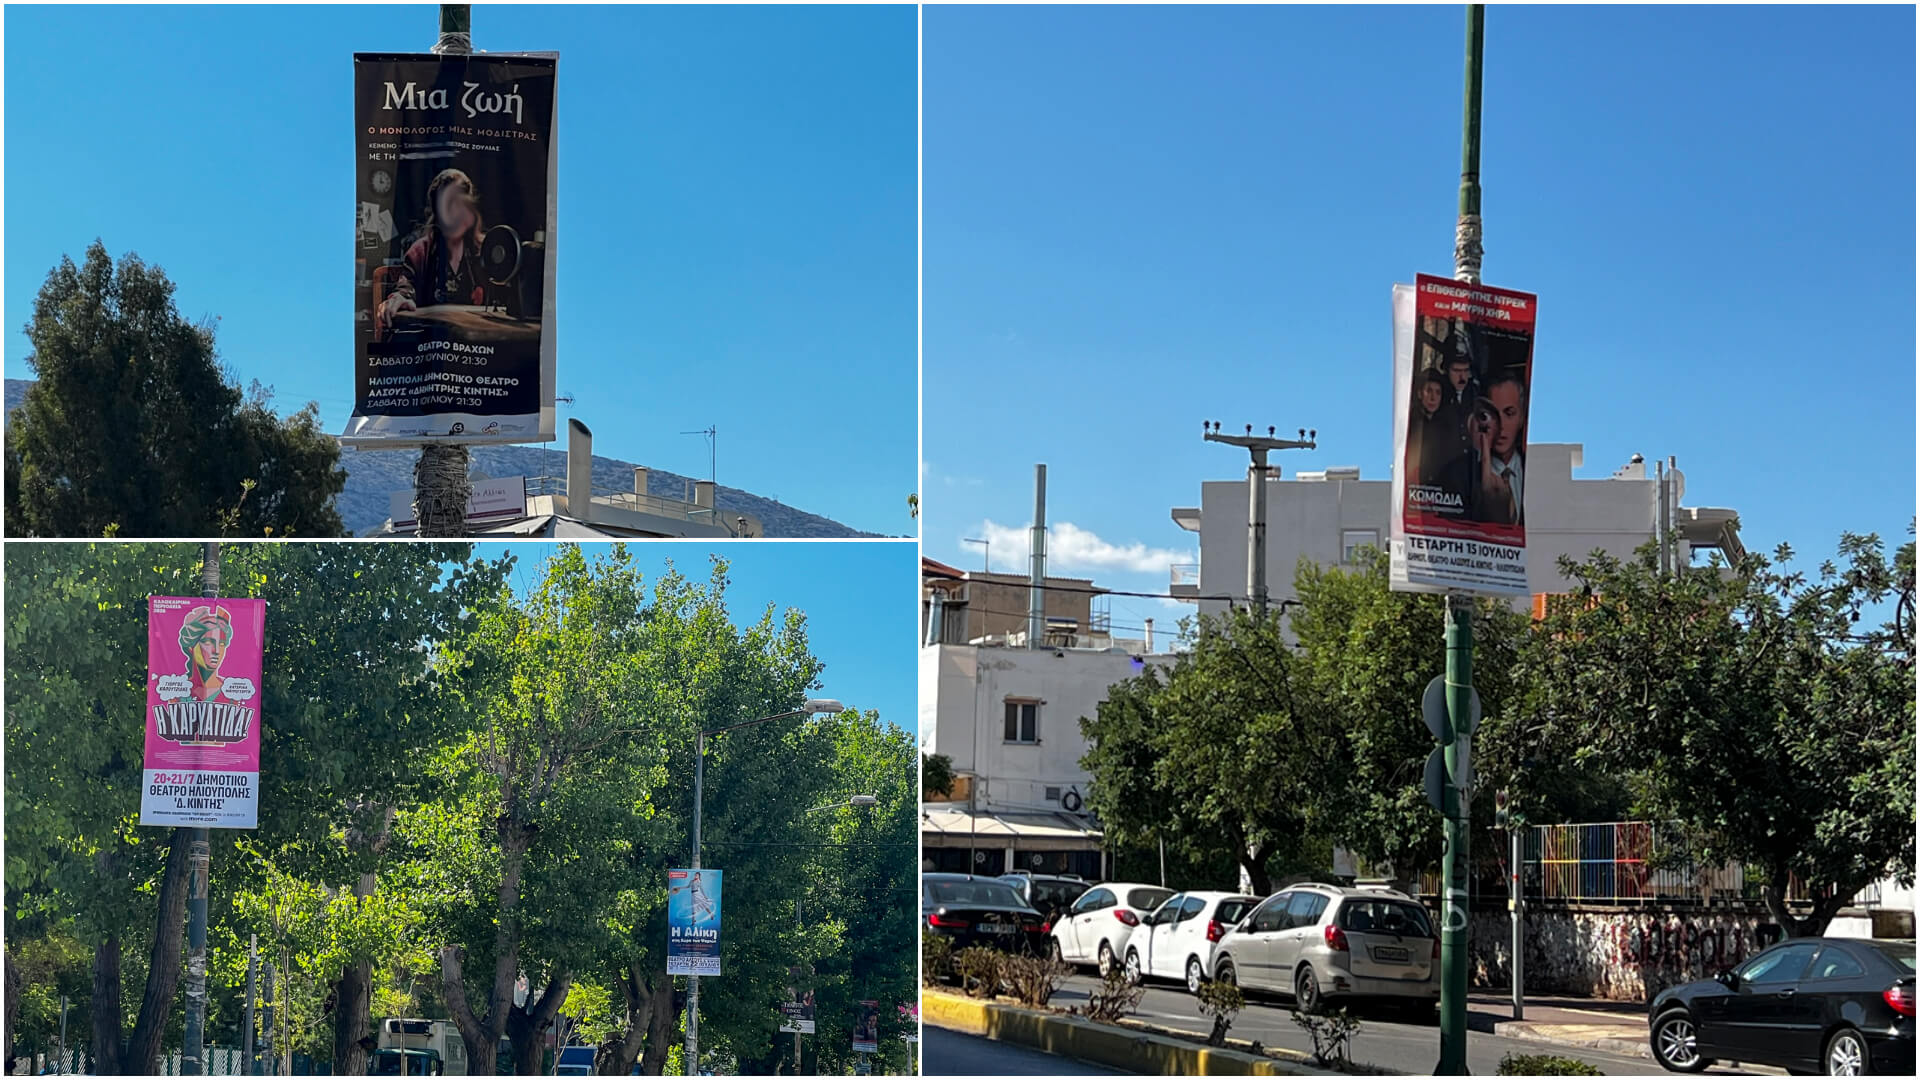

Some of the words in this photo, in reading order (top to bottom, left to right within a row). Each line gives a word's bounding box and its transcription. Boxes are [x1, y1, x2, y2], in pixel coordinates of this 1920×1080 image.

[382, 82, 449, 110] Μια
[462, 81, 523, 124] ζωή
[368, 126, 376, 134] Ο
[380, 126, 445, 134] ΜΟΝΟΛΟΓΟΣ
[449, 126, 472, 135] ΜΙΑΣ
[478, 129, 536, 140] ΜΟΔΙΣΤΡΑΣ
[1427, 283, 1492, 302] ΕΠΙΘΕΩΡΗΤΗΣ
[1494, 295, 1527, 309] ΝΤΡΕΙΚ
[1451, 301, 1484, 315] ΜΑΥΡΗ
[1486, 308, 1510, 320] ΧΗΡΑ
[418, 341, 450, 351] ΘΕΑΤΡΟ
[453, 342, 494, 354] ΒΡΑΧΩΝ
[369, 356, 412, 366] ΣΑΒΒΑΤΟ
[415, 356, 424, 364] 27
[462, 356, 487, 365] 21:30
[369, 375, 422, 385] ΗΛΙΟΥΠΟΛΗ
[424, 373, 473, 383] ΔΗΜΟΤΙΚΟ
[476, 376, 519, 385] ΘΕΑΤΡΟ
[369, 387, 406, 397] ΑΛΣΟΥΣ
[464, 387, 508, 396] ΚΙΝΤΗΣ»
[367, 399, 409, 408] ΣΑΒΒΑΤΟ
[456, 398, 482, 406] 21:30
[1409, 489, 1463, 506] ΚΩΜΩΔΙΑ
[1409, 537, 1463, 553] ΤΕΤΑΡΤΗ
[1466, 542, 1477, 555] 15
[1479, 546, 1520, 560] ΙΟΥΛΙΟΥ
[153, 706, 166, 735] Η
[168, 702, 254, 737] ΚΑΡΥΑΤΙΔΑ!
[154, 773, 195, 784] 20+21/7
[197, 774, 247, 786] ΔΗΜΟΤΙΚΟ
[150, 785, 187, 796] ΘΕΑΤΡΟ
[189, 786, 250, 798] ΗΛΙΟΥΠΟΛΗΣ
[174, 798, 186, 808] 'Δ.
[187, 798, 225, 809] ΚΙΝΤΗΣ'
[672, 927, 680, 937] Η
[685, 926, 717, 939] Αλίκη
